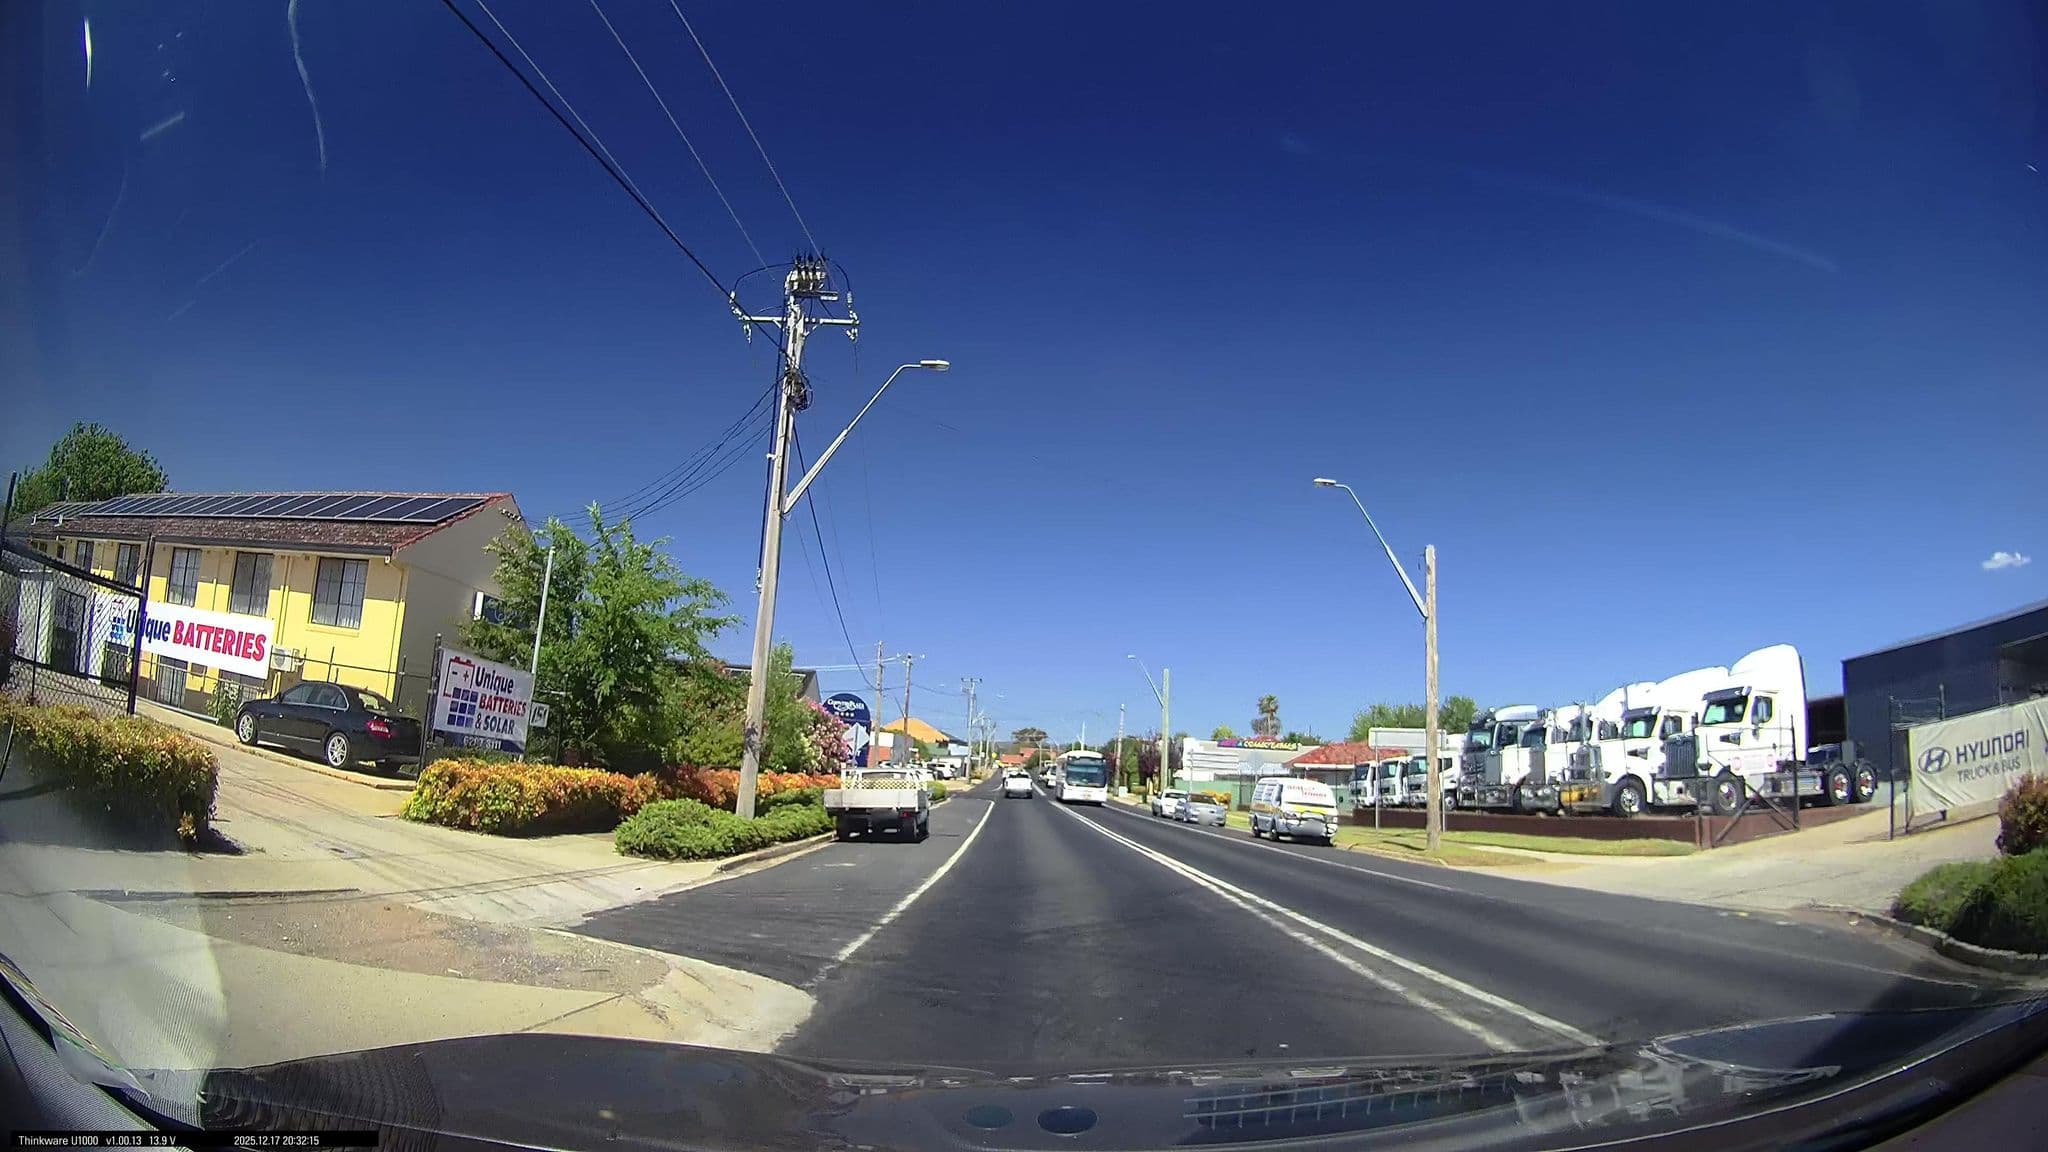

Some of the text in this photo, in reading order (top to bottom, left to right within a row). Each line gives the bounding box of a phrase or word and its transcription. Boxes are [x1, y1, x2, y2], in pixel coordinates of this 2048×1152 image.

[173, 620, 267, 661] BATTERIES
[475, 666, 514, 695] Unique
[479, 693, 527, 717] BATTERIES
[475, 712, 515, 735] & SOLAR
[1956, 729, 2029, 764] HYUNDAI
[1957, 765, 1991, 782] TRUCK
[2001, 755, 2021, 773] BUS
